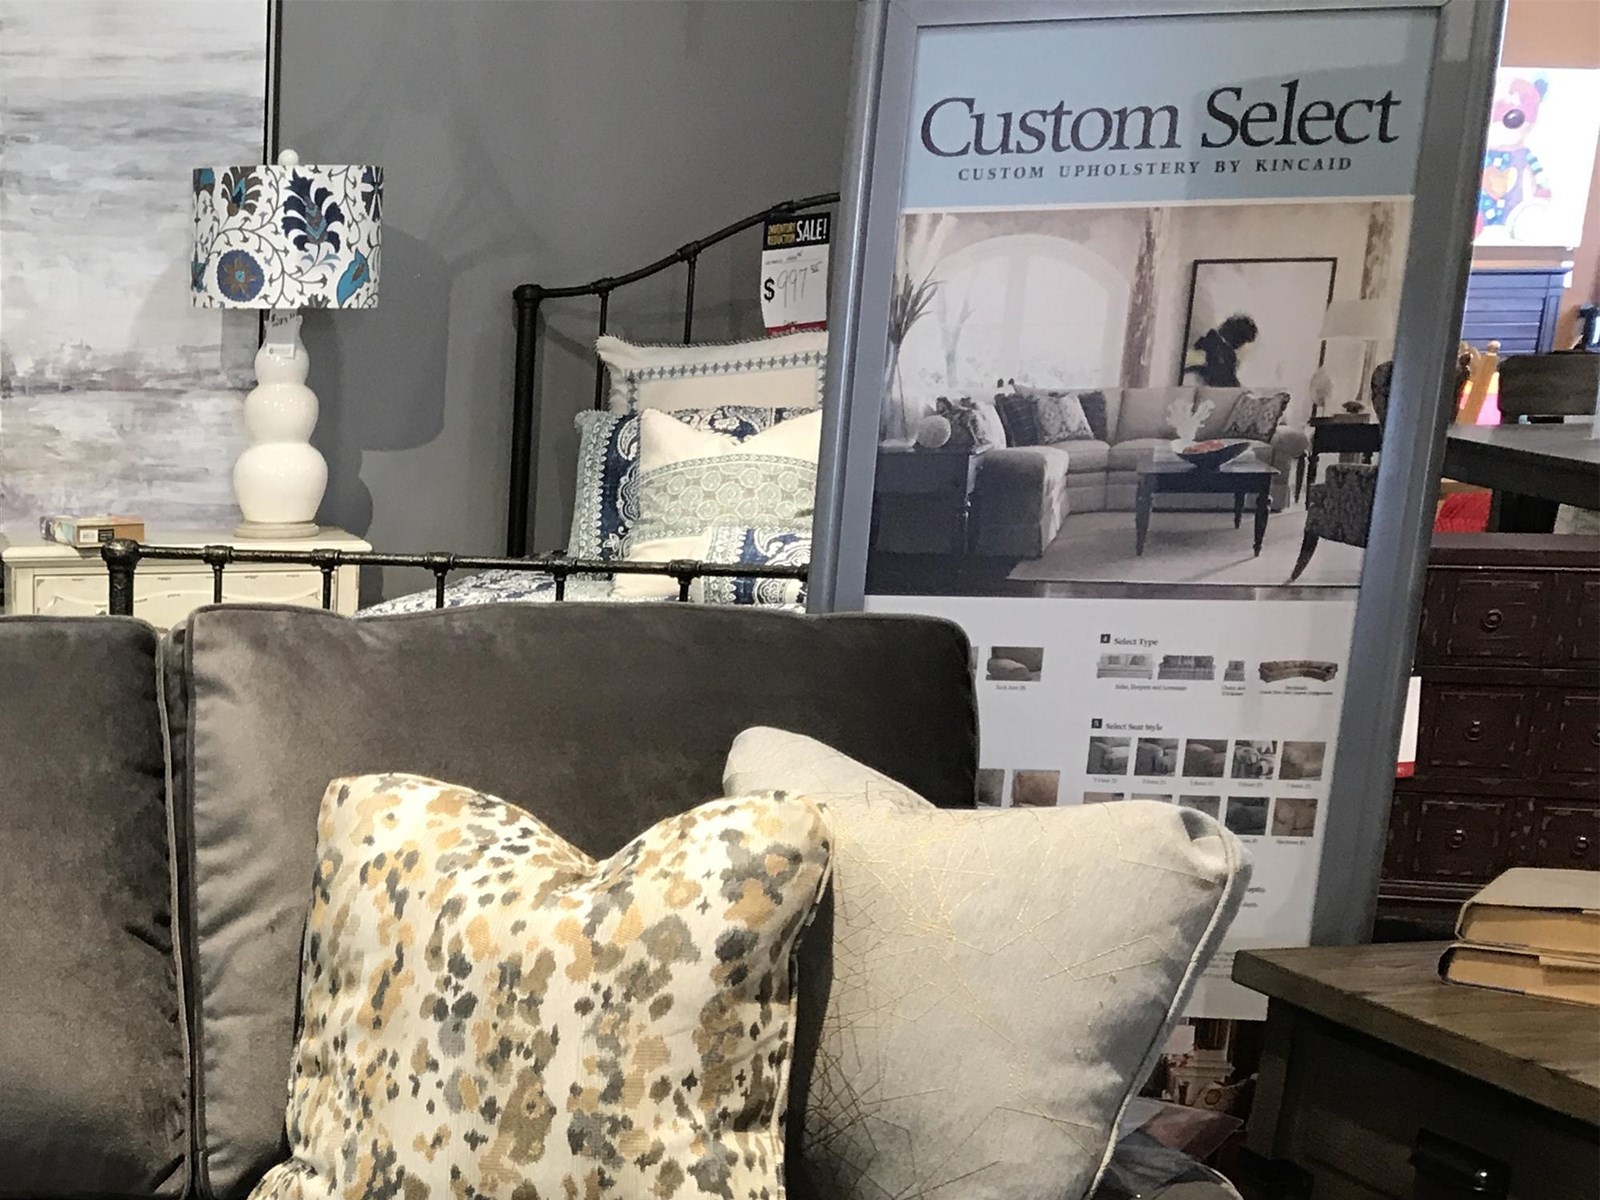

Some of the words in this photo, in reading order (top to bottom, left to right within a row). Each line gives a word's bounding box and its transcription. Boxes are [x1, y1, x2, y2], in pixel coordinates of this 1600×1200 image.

[920, 96, 1183, 158] Custom
[1200, 78, 1402, 148] Select
[957, 166, 1045, 181] CUSTOM
[1058, 160, 1200, 179] UPHOLSTERY
[1214, 159, 1241, 174] BY
[1255, 156, 1353, 172] KINCAID
[796, 217, 828, 242] SALE!
[1114, 637, 1137, 645] Select
[1139, 638, 1159, 647] Type
